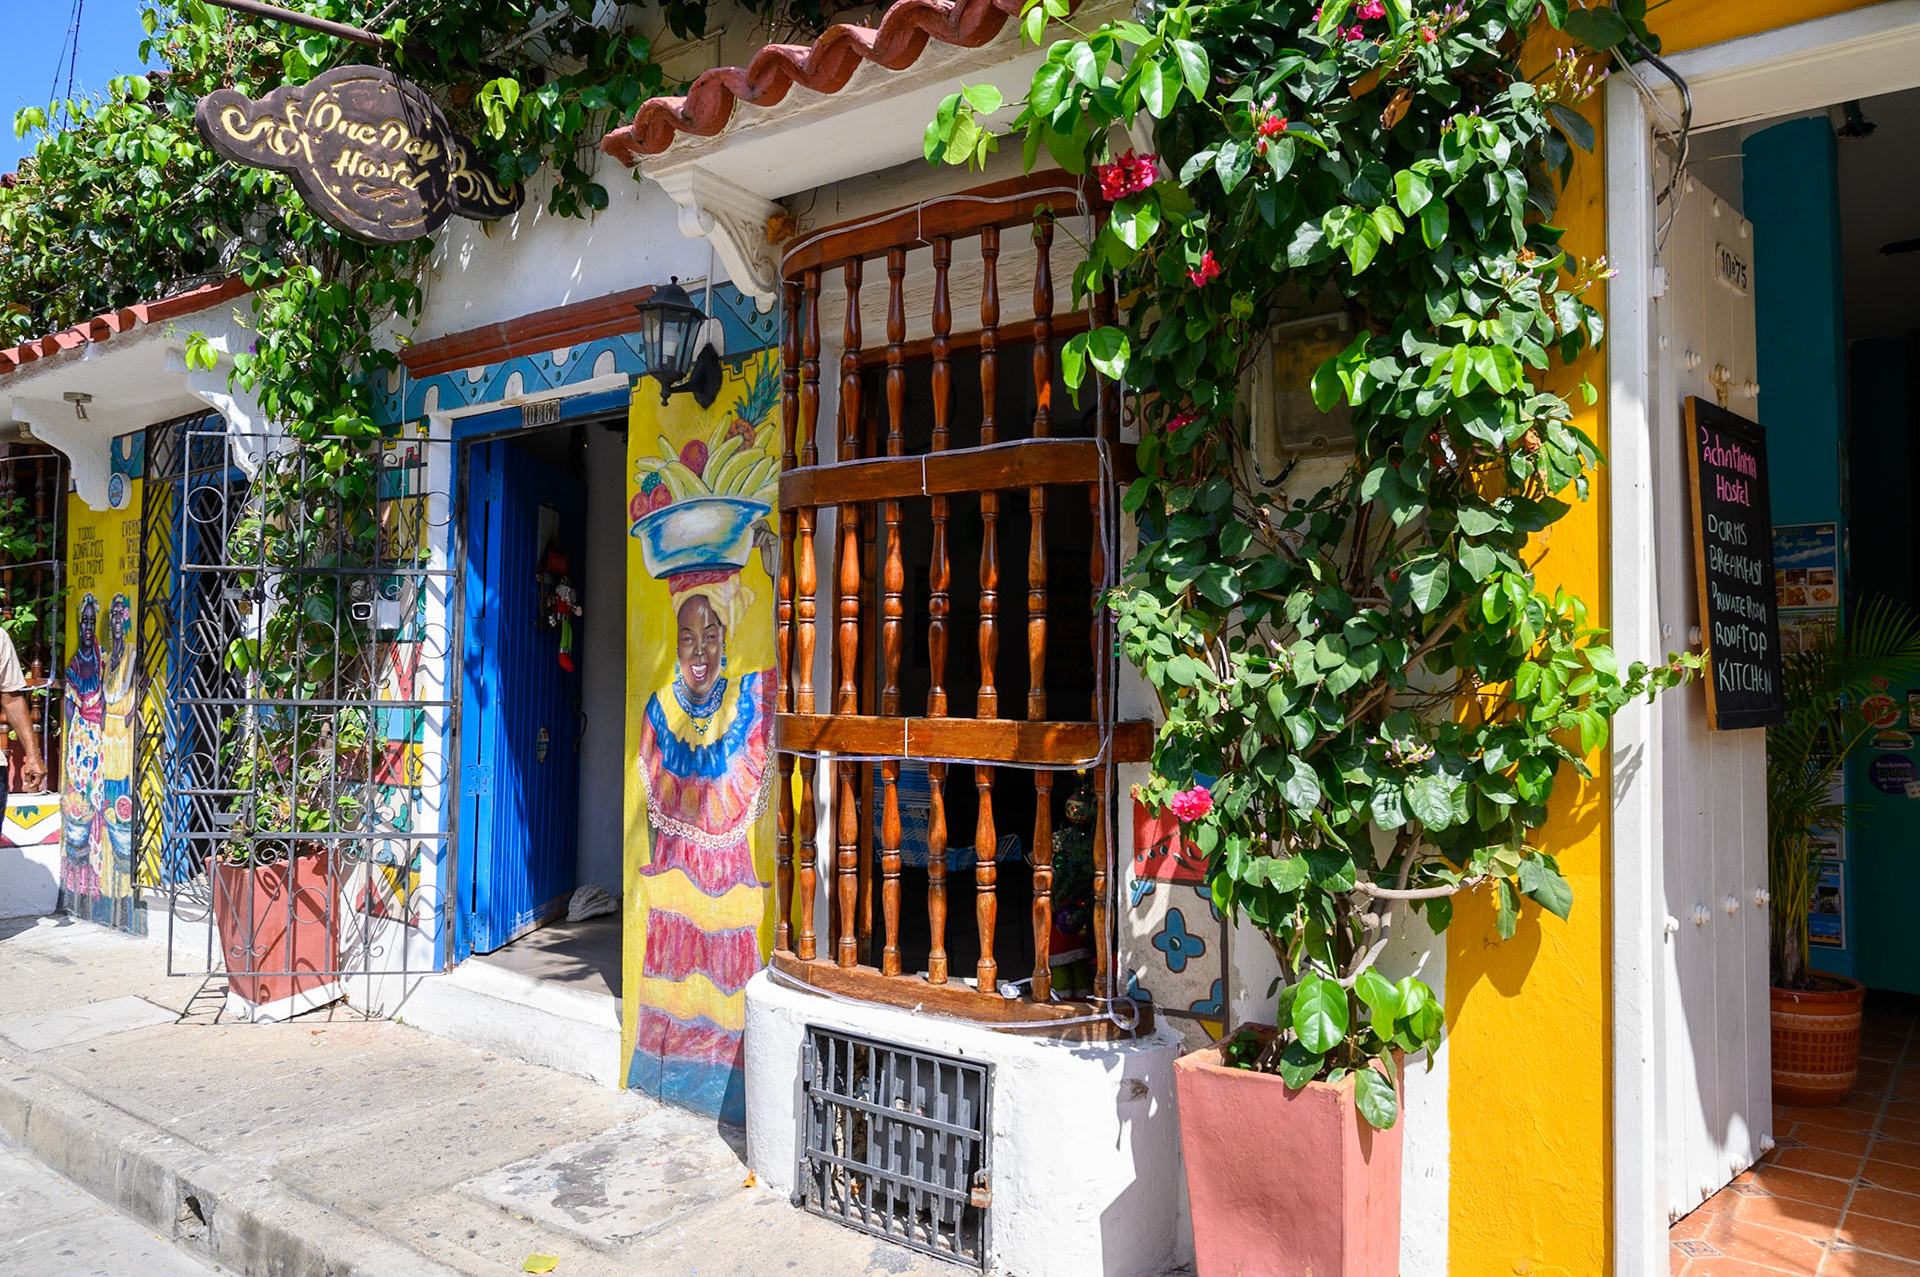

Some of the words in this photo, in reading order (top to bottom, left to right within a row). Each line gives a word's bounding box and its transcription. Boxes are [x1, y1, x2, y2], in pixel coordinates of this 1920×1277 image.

[315, 101, 378, 145] One
[380, 116, 441, 167] Day
[332, 149, 431, 191] Hostel
[1707, 513, 1748, 546] DORMS
[1709, 544, 1762, 586] BREAKFAST
[1711, 580, 1746, 617] PRIVATE
[1746, 595, 1767, 624] ROOM
[1715, 621, 1768, 660] ROOFTOP
[1718, 658, 1773, 694] KITCHEN
